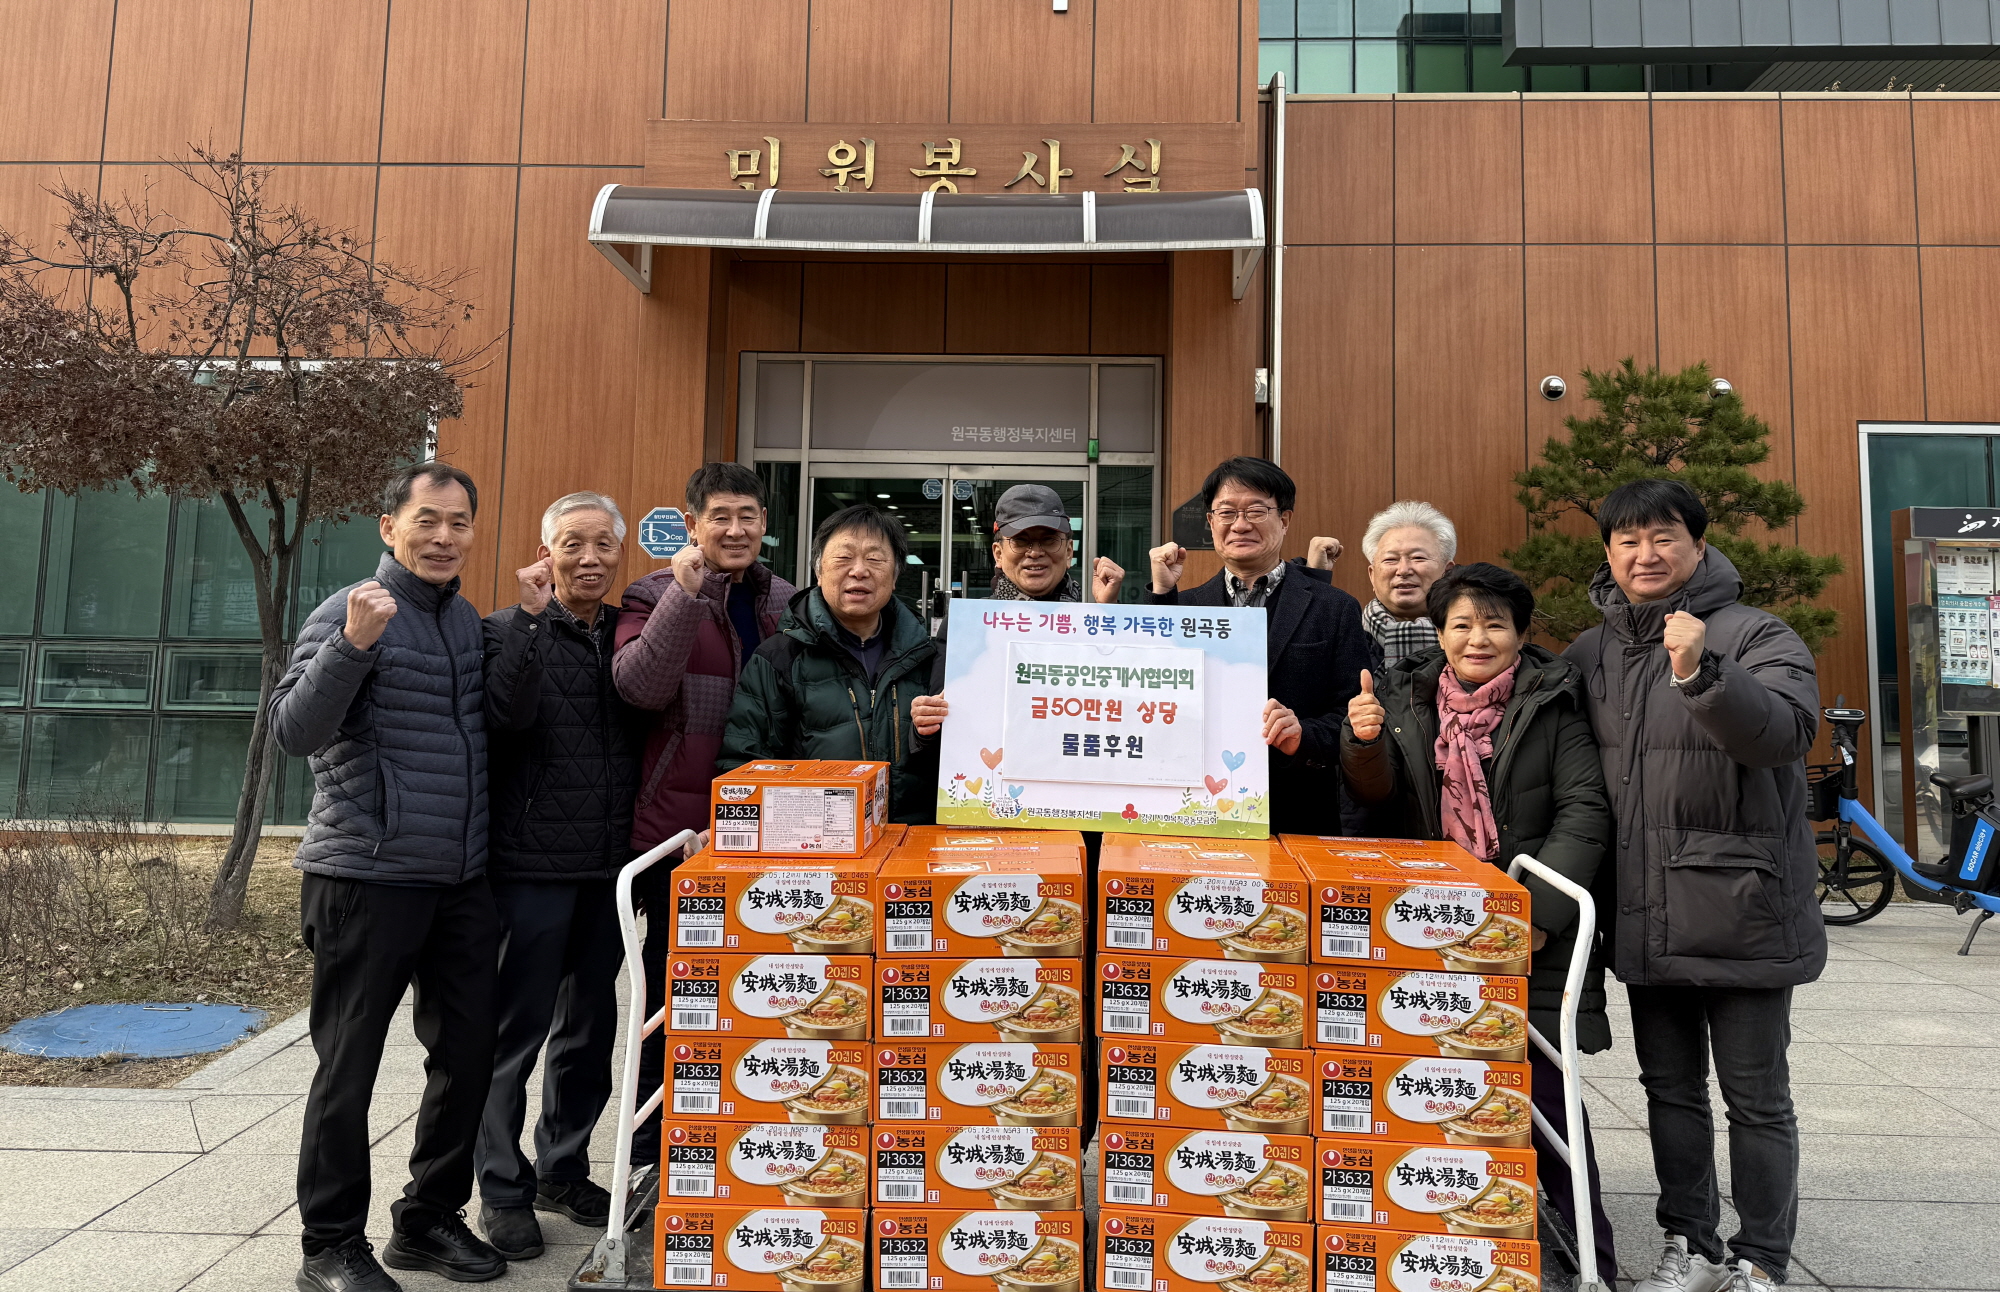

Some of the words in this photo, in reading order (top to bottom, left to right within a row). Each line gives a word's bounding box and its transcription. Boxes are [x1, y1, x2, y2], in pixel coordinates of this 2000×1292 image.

[951, 426, 1076, 443] 원곡동행정복지센터
[983, 611, 1033, 633] 나누는
[1038, 613, 1077, 635] 기쁨,
[1083, 614, 1117, 636] 행복
[1123, 616, 1175, 638] 가득한
[1180, 617, 1232, 640] 원곡동
[1015, 662, 1194, 690] 원곡동공인중개사협의회
[1031, 696, 1123, 722] 금50만원
[1137, 701, 1178, 724] 상당
[1062, 733, 1143, 759] 물품후원
[717, 805, 758, 818] 가3632
[1027, 807, 1102, 819] 원곡동행정복지센터
[1967, 850, 1979, 873] SOCAR
[697, 882, 725, 894] 농심
[858, 882, 866, 893] S
[904, 886, 932, 898] 농심
[1125, 883, 1154, 895] 농심
[1341, 891, 1370, 904] 농심
[680, 899, 723, 912] 가3632
[888, 903, 930, 916] 가3632
[1109, 899, 1152, 913] 가3632
[1511, 901, 1520, 912] S
[1324, 908, 1368, 922] 가3632
[691, 964, 719, 977] 농심
[901, 970, 929, 983] 농심
[1063, 970, 1070, 981] S
[1122, 967, 1150, 979] 농심
[674, 981, 716, 994] 가3632
[1286, 976, 1294, 987] S
[1337, 977, 1366, 990] 농심
[885, 988, 928, 1001] 가3632
[1105, 983, 1148, 997] 가3632
[1319, 994, 1364, 1008] 가3632
[693, 1048, 721, 1060] 농심
[854, 1052, 861, 1063] S
[898, 1053, 926, 1065] 농심
[1127, 1051, 1156, 1064] 농심
[676, 1064, 719, 1078] 가3632
[1293, 1061, 1301, 1072] S
[1342, 1065, 1372, 1078] 농심
[881, 1070, 924, 1083] 가3632
[1110, 1067, 1154, 1082] 가3632
[1325, 1082, 1370, 1096] 가3632
[688, 1131, 716, 1143] 농심
[896, 1136, 925, 1148] 농심
[1059, 1138, 1067, 1149] S
[1125, 1137, 1154, 1150] 농심
[671, 1148, 714, 1161] 가3632
[880, 1153, 923, 1166] 가3632
[1108, 1154, 1151, 1168] 가3632
[1343, 1154, 1372, 1167] 농심
[1515, 1165, 1523, 1176] S
[1325, 1170, 1370, 1185] 가3632
[685, 1219, 713, 1231] 농심
[899, 1223, 927, 1235] 농심
[1125, 1222, 1154, 1236] 농심
[668, 1236, 711, 1249] 가3632
[882, 1240, 925, 1253] 가3632
[1108, 1239, 1151, 1254] 가3632
[1346, 1239, 1376, 1253] 농심
[1328, 1256, 1374, 1271] 가3632
[1520, 1254, 1528, 1265] S
